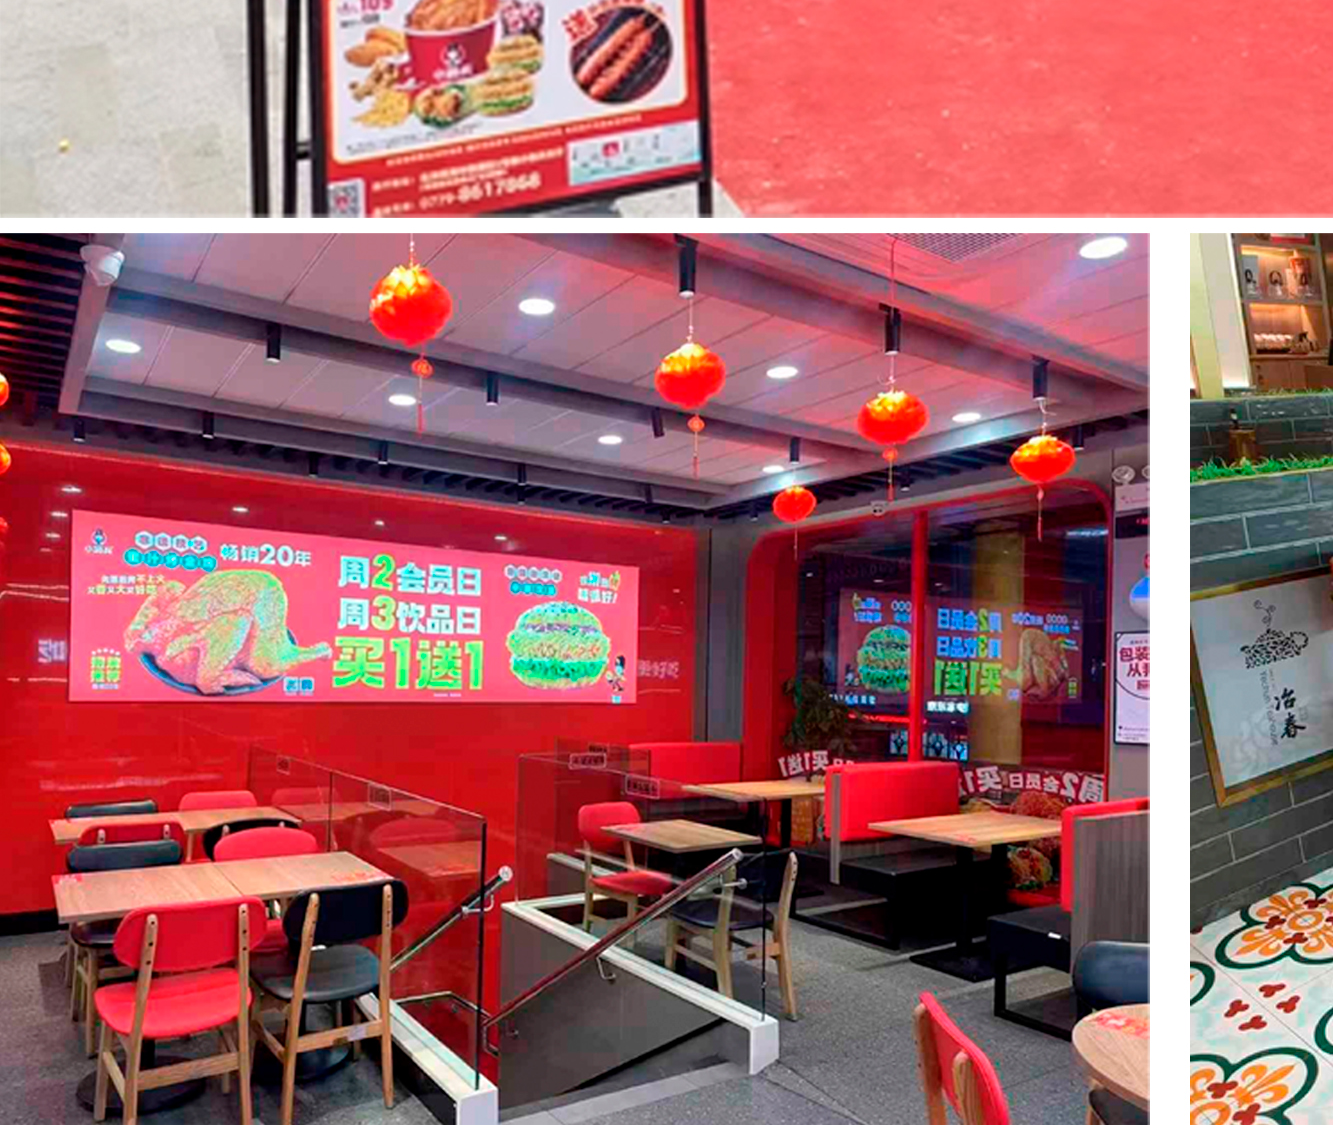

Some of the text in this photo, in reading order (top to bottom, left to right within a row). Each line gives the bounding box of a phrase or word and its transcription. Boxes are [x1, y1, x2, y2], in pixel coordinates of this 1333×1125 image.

[219, 543, 312, 567] 畅销20年
[338, 554, 482, 597] 周2会员日
[337, 595, 482, 635] 周3饮品日
[331, 636, 485, 690] 买1送1
